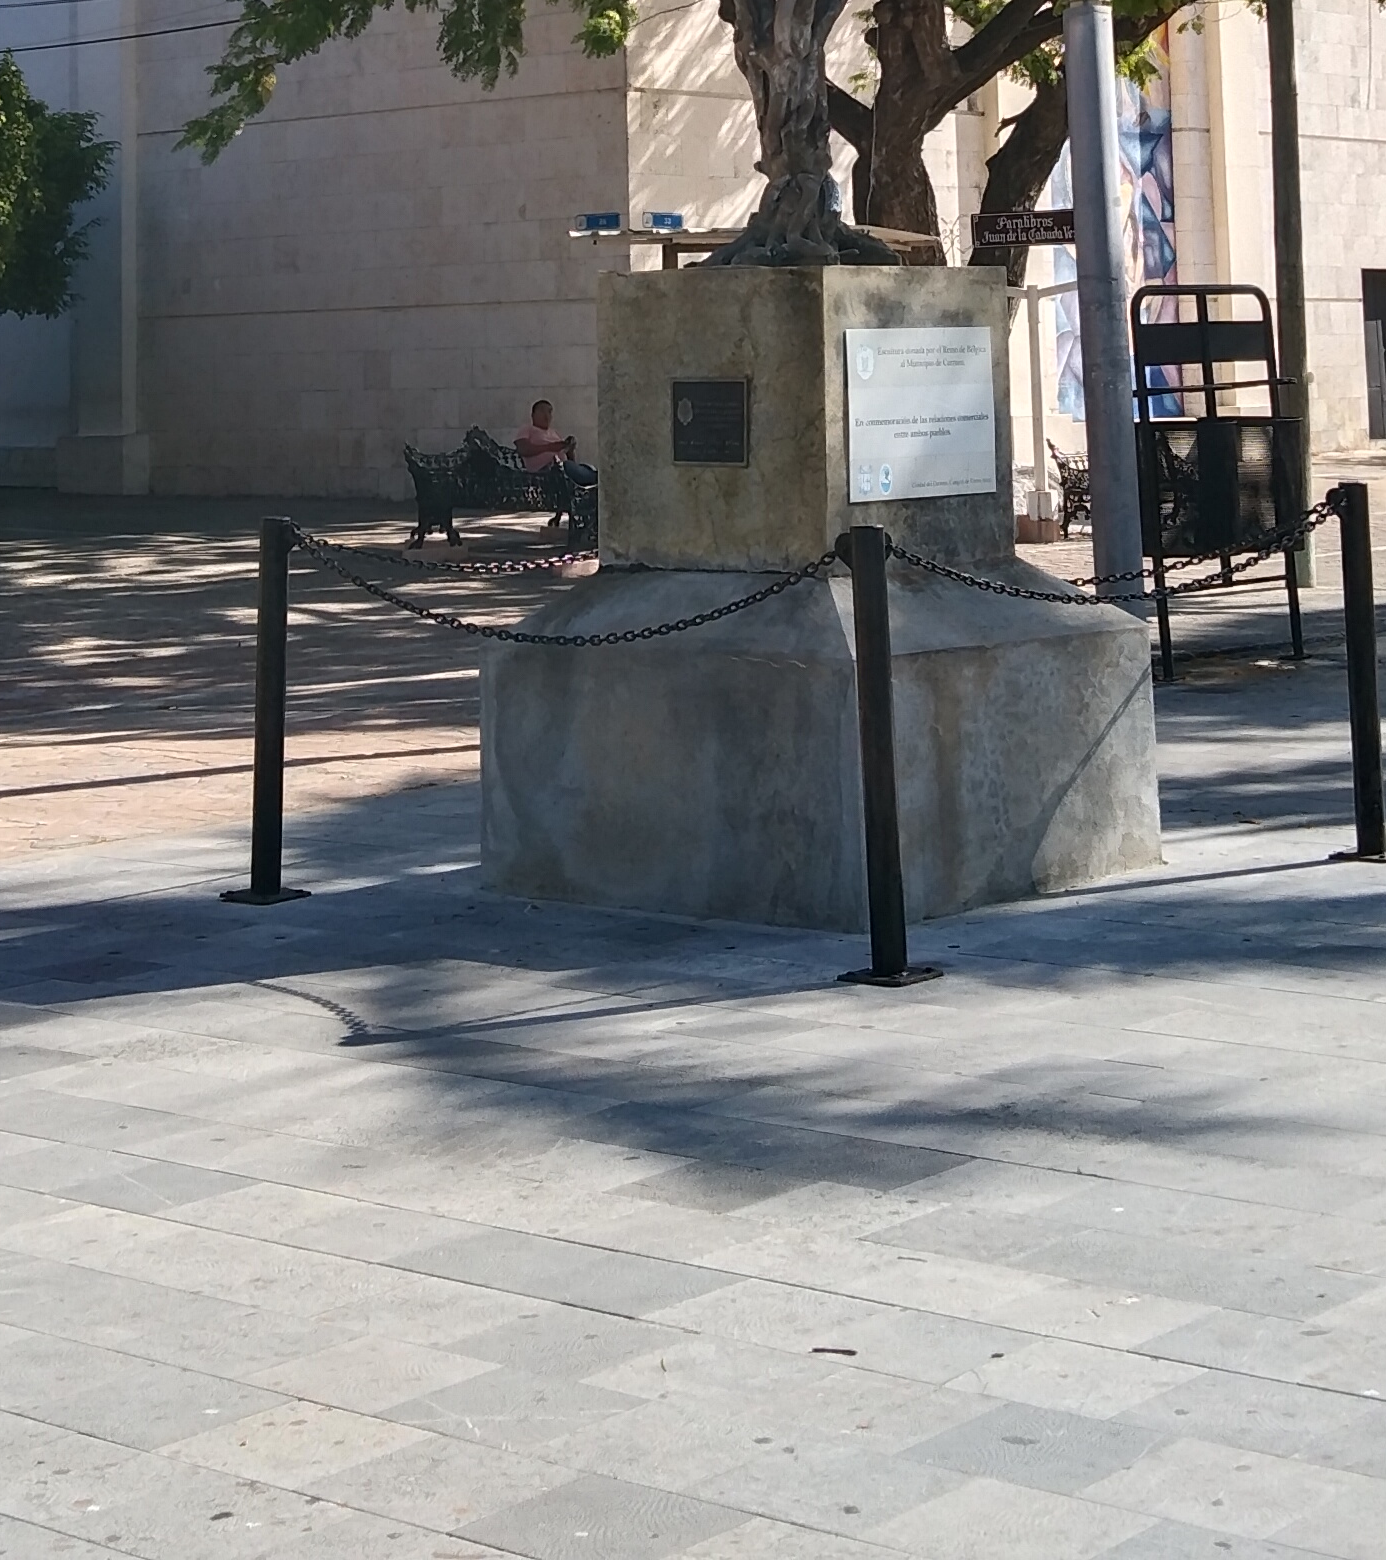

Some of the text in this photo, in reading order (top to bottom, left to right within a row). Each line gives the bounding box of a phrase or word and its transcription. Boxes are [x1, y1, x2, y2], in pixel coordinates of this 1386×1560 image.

[996, 214, 1053, 230] Paralibros
[982, 231, 1006, 243] Juan
[1007, 229, 1017, 241] de
[1018, 229, 1027, 241] la
[855, 418, 864, 427] En
[912, 415, 919, 425] de
[919, 415, 928, 424] las
